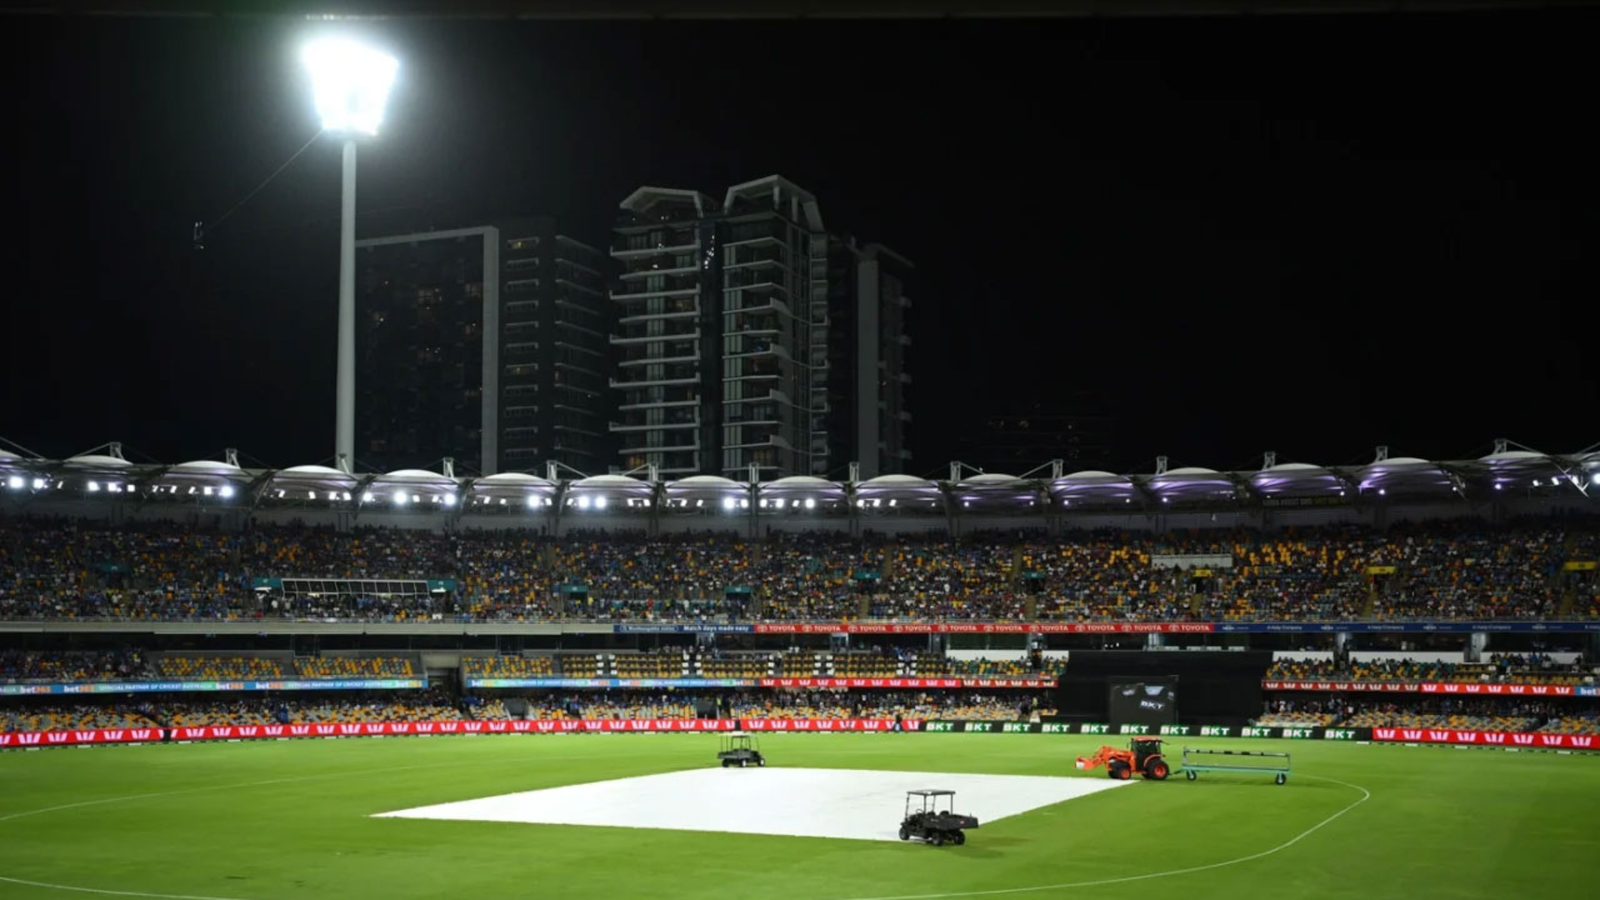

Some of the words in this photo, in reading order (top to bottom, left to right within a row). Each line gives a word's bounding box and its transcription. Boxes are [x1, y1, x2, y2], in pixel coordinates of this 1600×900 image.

[20, 685, 50, 694] bet365
[64, 685, 94, 693] bet365
[256, 682, 284, 690] bet365
[1141, 701, 1164, 710] BKT
[926, 722, 954, 732] BKT
[965, 723, 992, 732] BKT
[1003, 723, 1031, 732] BKT
[1041, 723, 1070, 733] BKT
[1081, 724, 1109, 733] BKT
[1120, 725, 1149, 733] BKT
[1160, 725, 1189, 734] BKT
[1200, 726, 1229, 735] BKT
[1241, 727, 1271, 737] BKT
[1282, 728, 1312, 737] BKT
[1324, 729, 1355, 738] BKT
